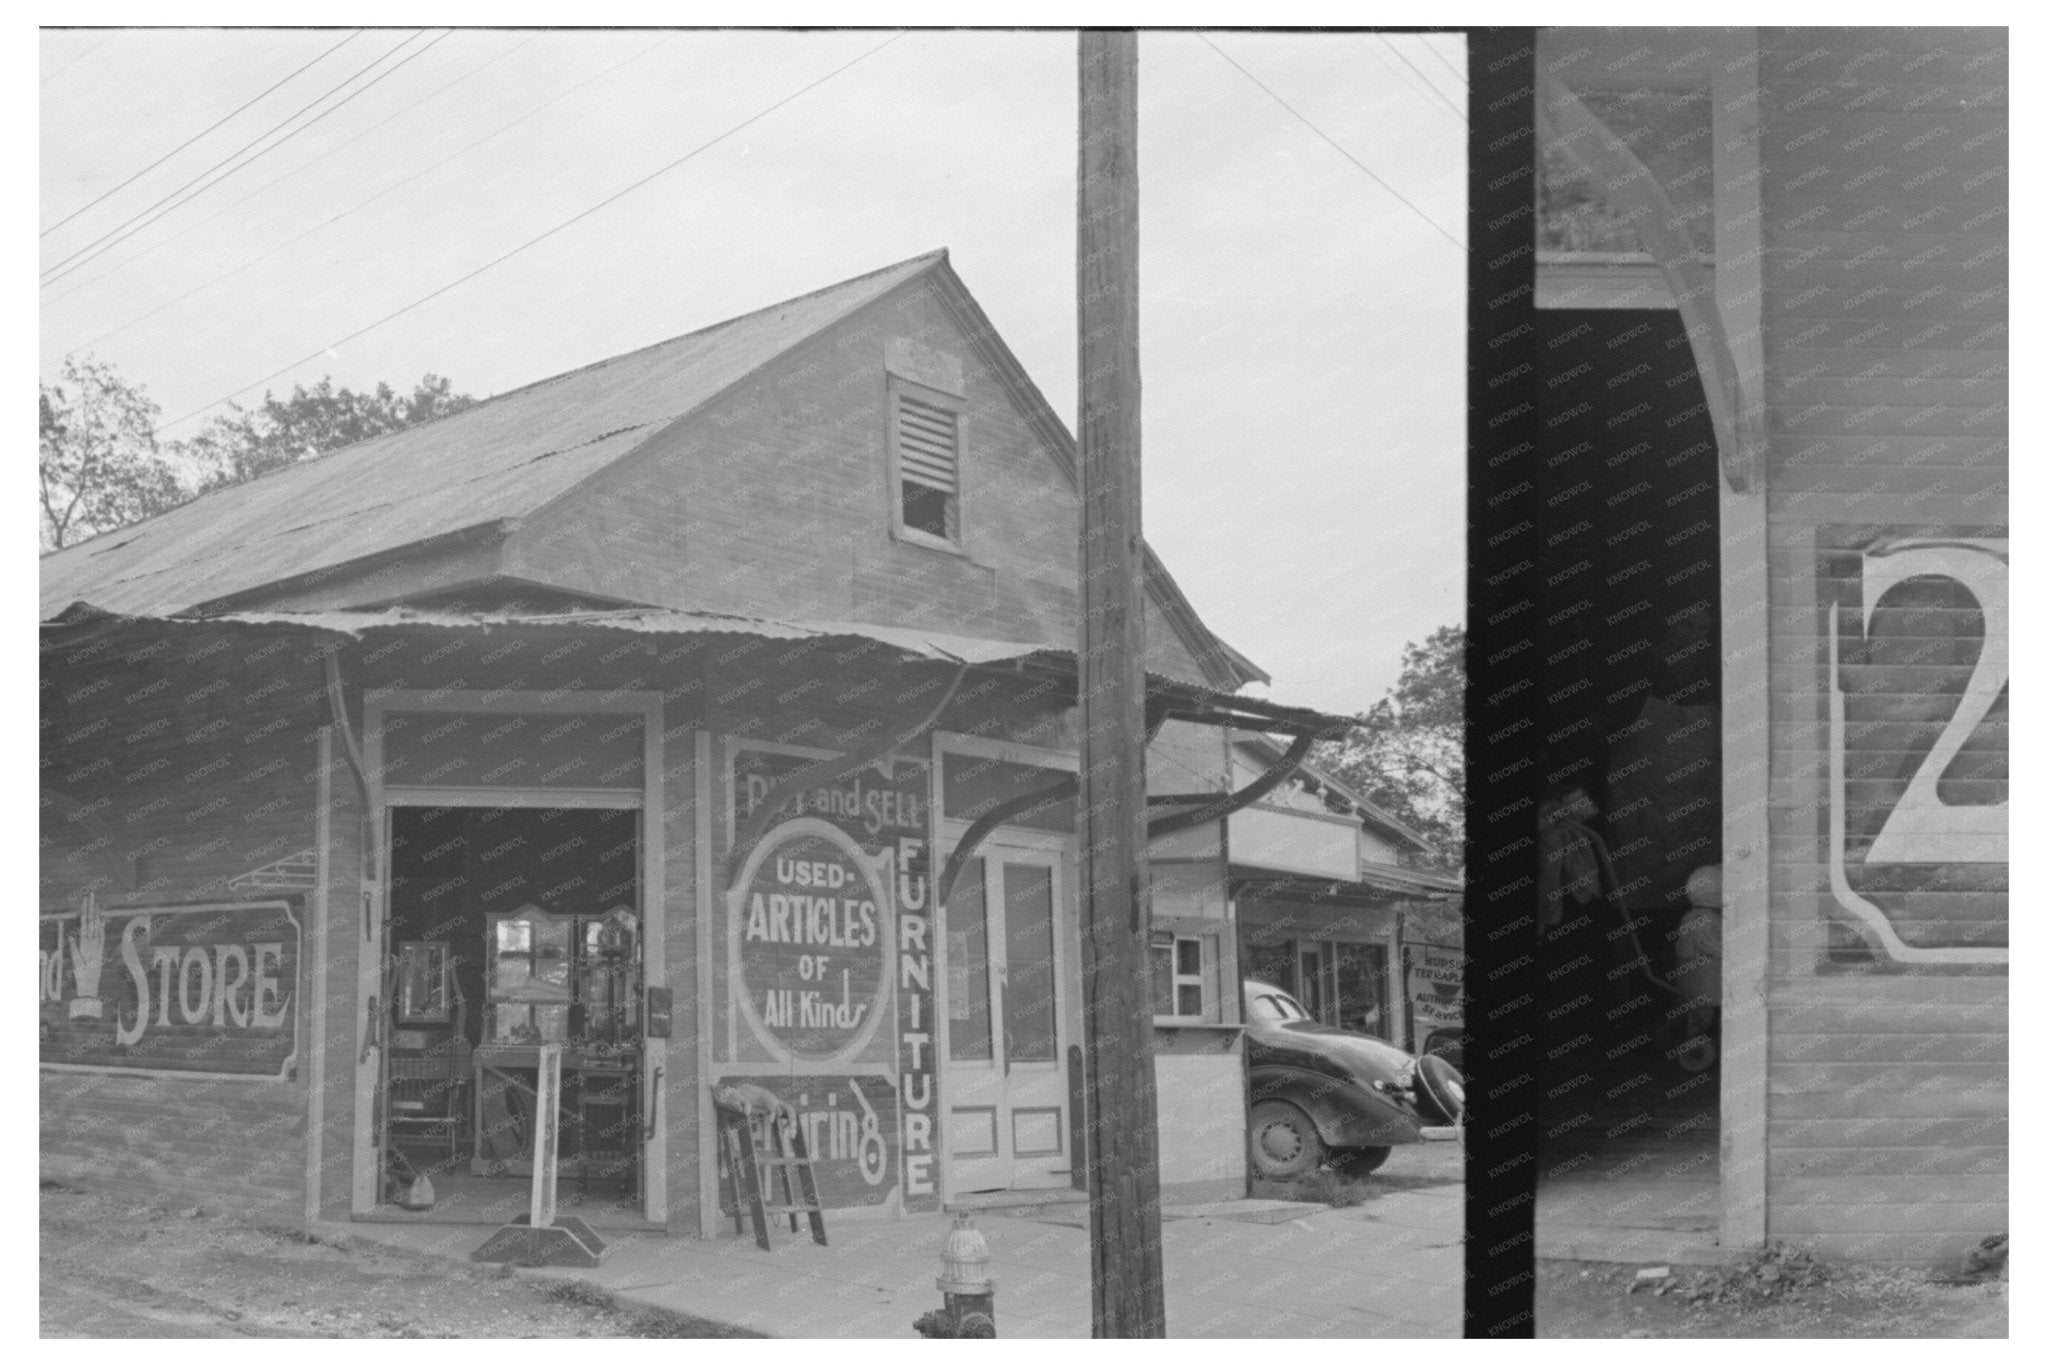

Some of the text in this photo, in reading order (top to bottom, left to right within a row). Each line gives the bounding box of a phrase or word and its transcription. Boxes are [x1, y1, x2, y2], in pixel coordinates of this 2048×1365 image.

[816, 779, 860, 816] and
[864, 788, 922, 834] SELL
[777, 856, 855, 888] USED-
[746, 893, 875, 948] ARTICLES
[117, 914, 291, 1045] STORE
[799, 955, 829, 981] OF
[764, 969, 866, 1030] All Kinds
[899, 838, 933, 1195] FURNITURE
